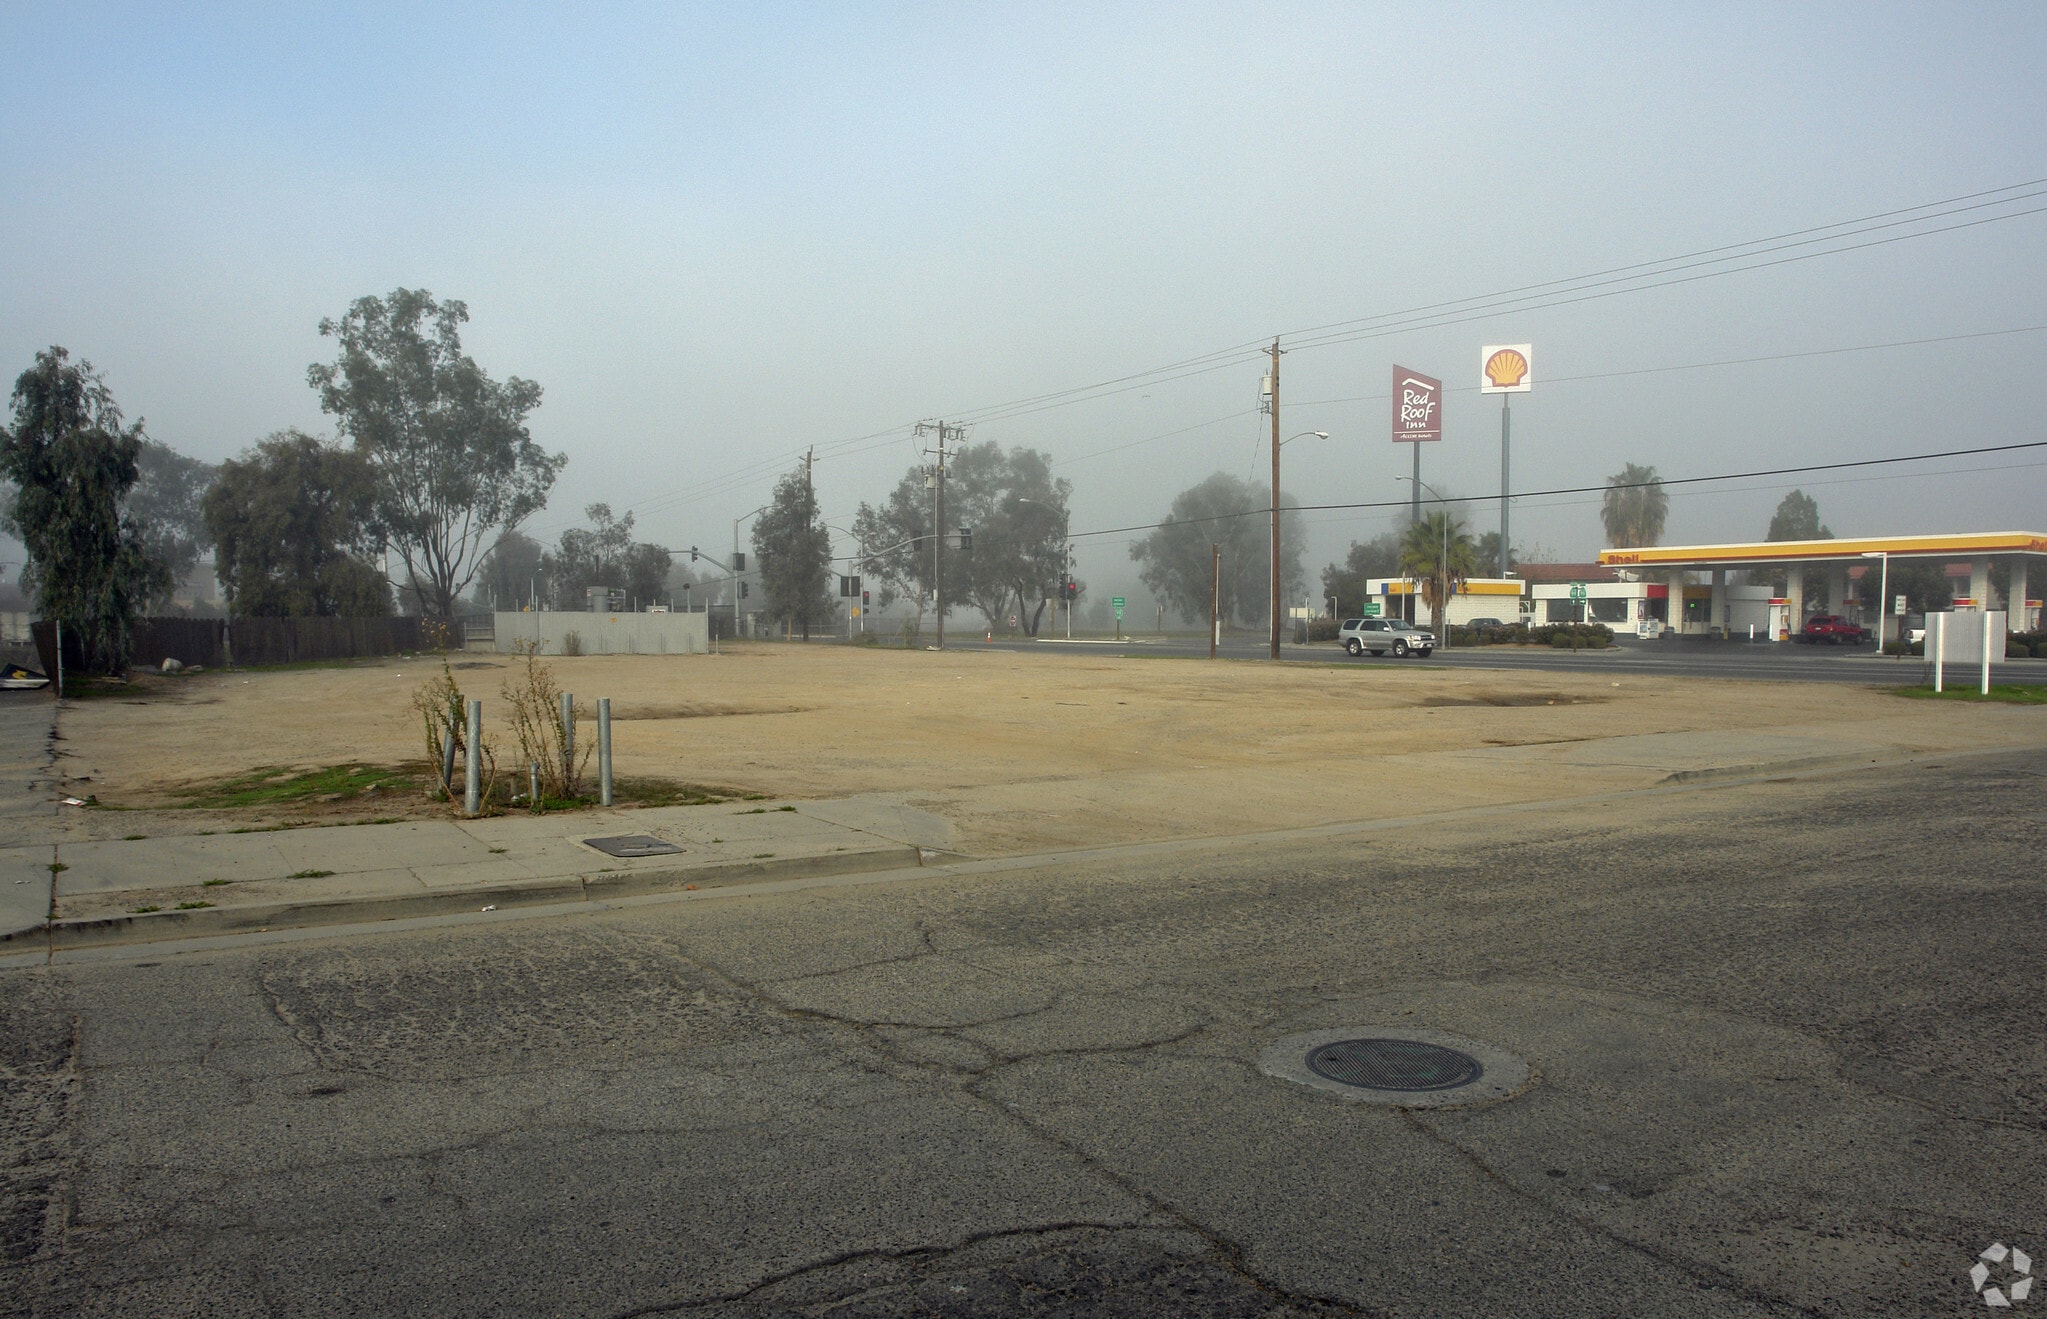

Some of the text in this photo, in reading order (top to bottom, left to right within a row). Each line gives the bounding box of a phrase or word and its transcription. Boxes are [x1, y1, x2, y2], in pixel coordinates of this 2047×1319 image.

[1404, 389, 1429, 405] Red
[1401, 402, 1436, 422] Roof
[1608, 554, 1639, 565] Shell
